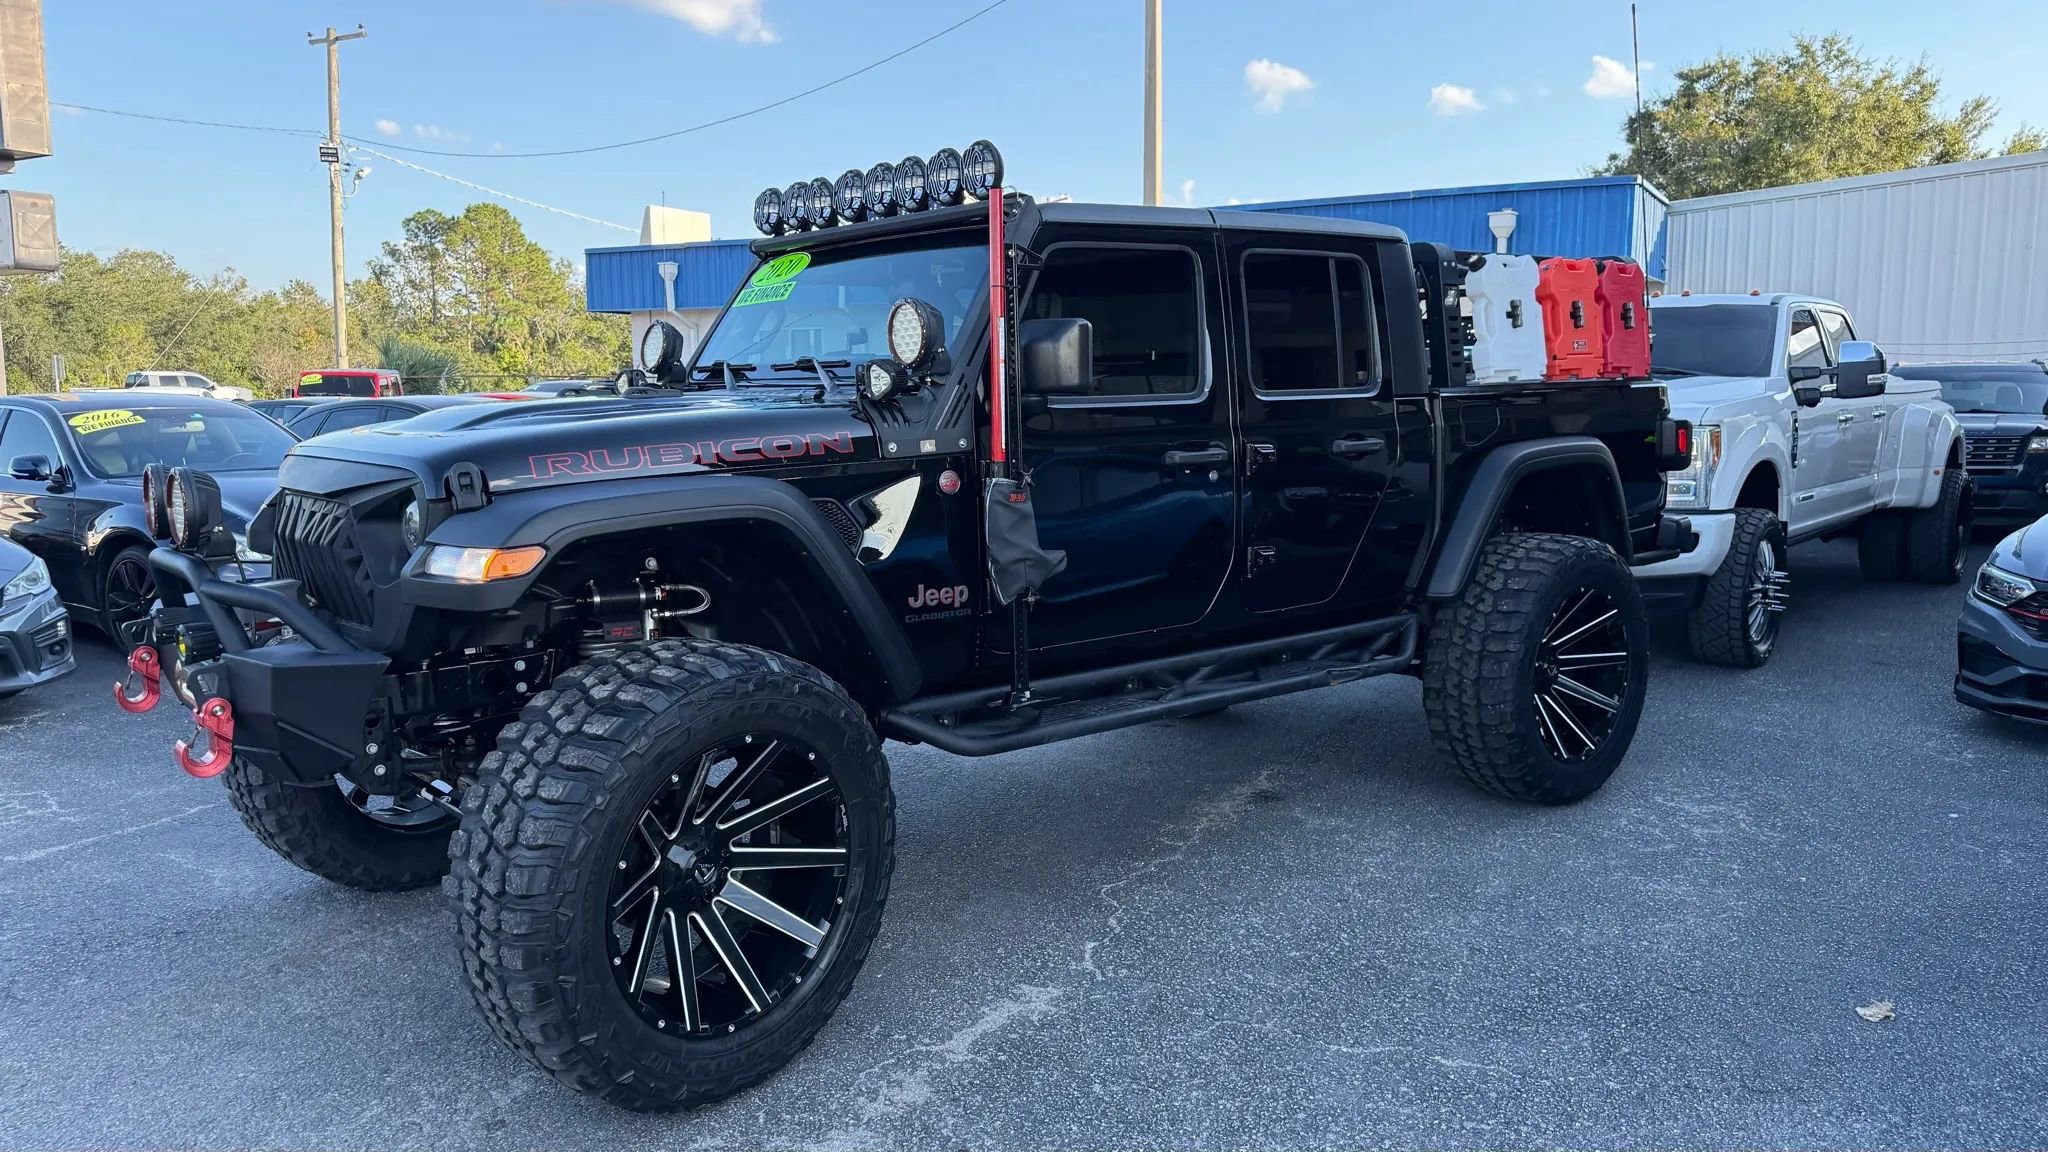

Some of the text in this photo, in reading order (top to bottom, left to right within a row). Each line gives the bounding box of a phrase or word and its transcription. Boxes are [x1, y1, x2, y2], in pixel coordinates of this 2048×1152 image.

[863, 168, 882, 207] KC
[892, 164, 913, 205] KC
[926, 155, 947, 198] KC
[961, 148, 983, 192] KC
[804, 185, 821, 222] KC
[833, 175, 852, 213] KC
[755, 256, 804, 284] 2020
[737, 283, 793, 305] WE FINANCE
[81, 417, 141, 432] WE FINANCE
[82, 412, 120, 424] 2016
[528, 431, 854, 479] RUBICON
[907, 584, 969, 608] Jeep
[905, 608, 973, 623] GLADIATOR
